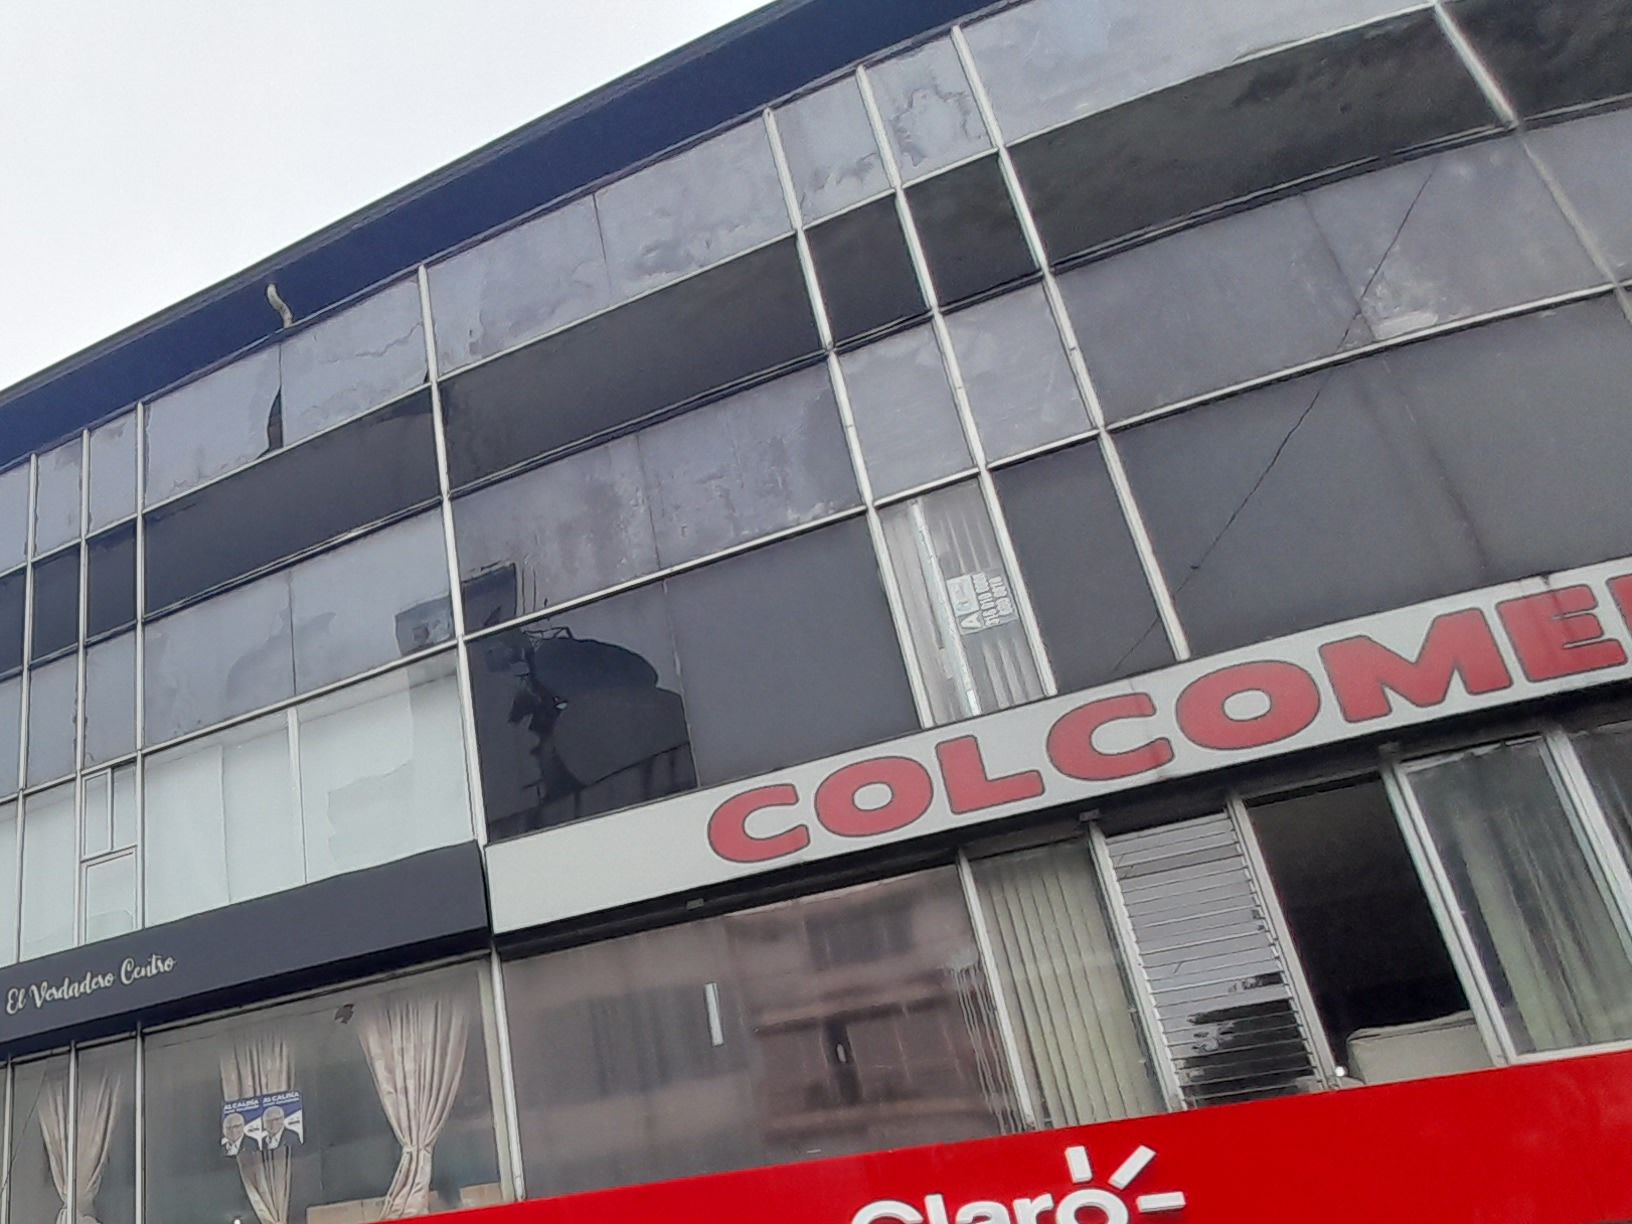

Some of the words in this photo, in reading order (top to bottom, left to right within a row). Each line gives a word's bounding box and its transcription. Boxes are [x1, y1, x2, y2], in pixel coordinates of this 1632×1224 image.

[707, 574, 1632, 863] COLCOME
[6, 987, 28, 1015] El
[29, 971, 116, 1009] Verdadero
[120, 953, 177, 987] Centro
